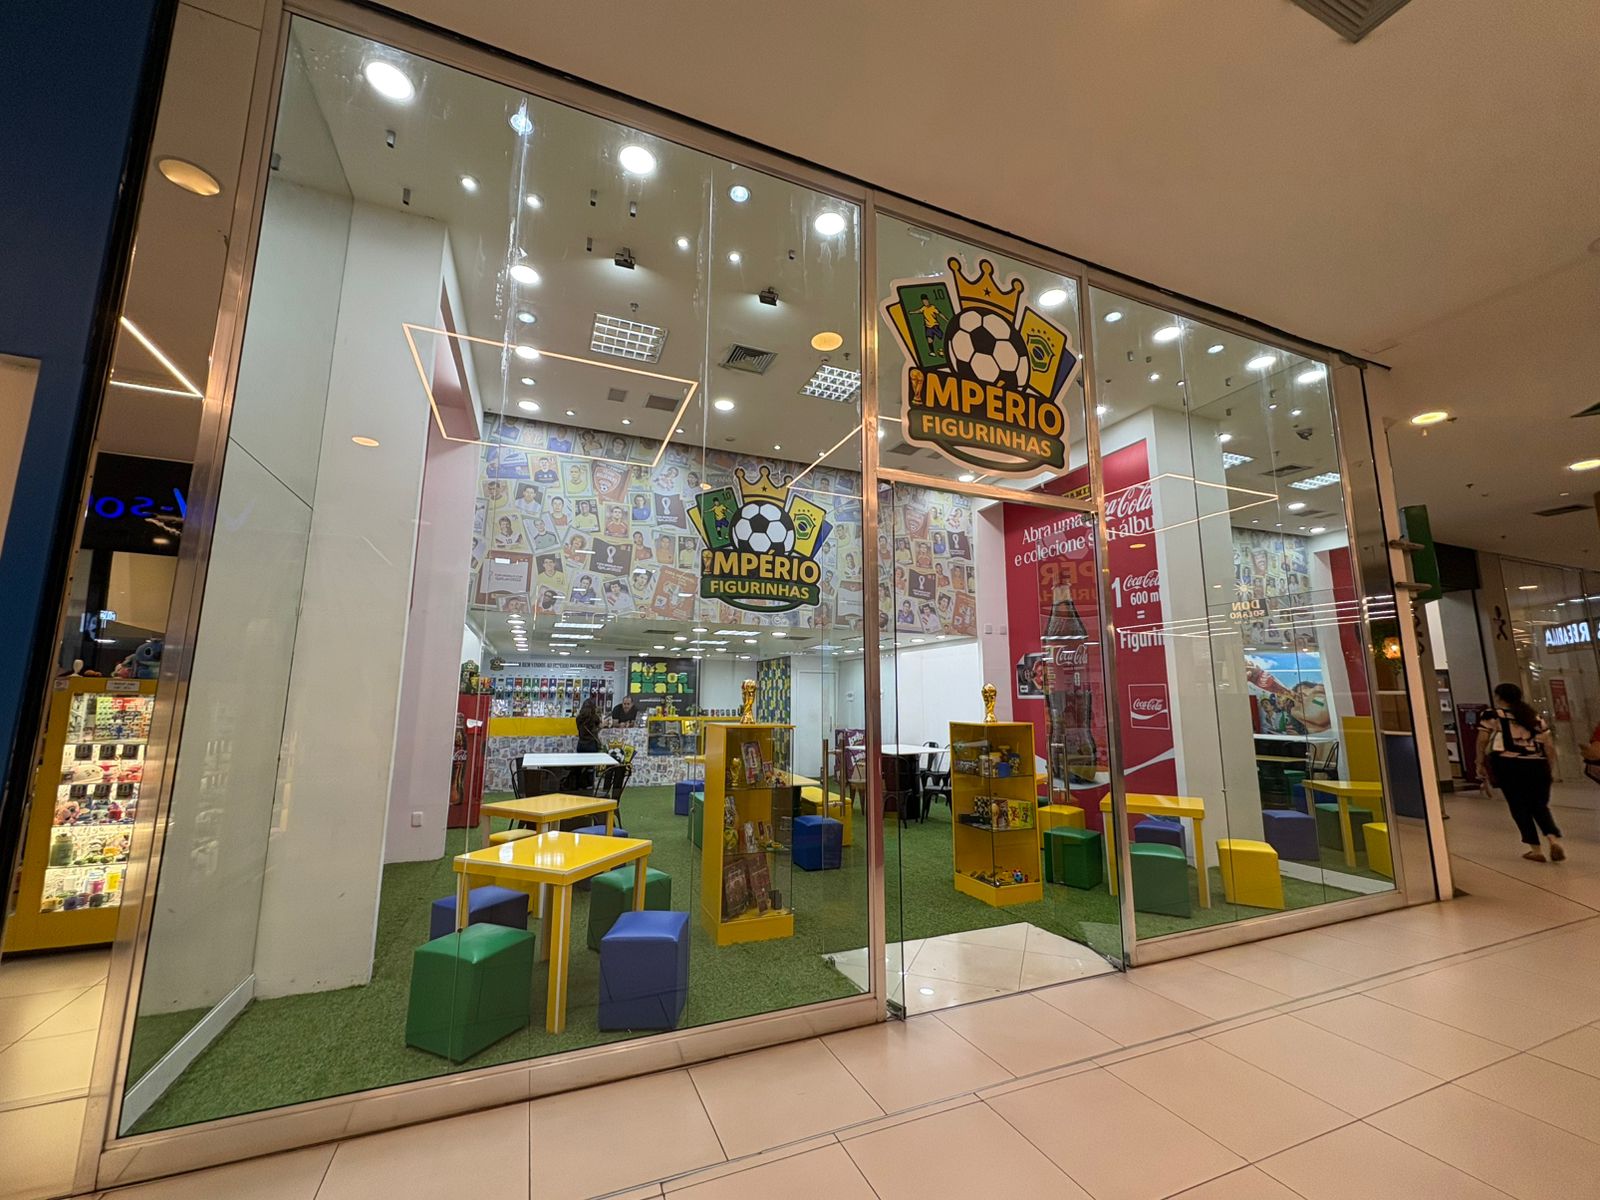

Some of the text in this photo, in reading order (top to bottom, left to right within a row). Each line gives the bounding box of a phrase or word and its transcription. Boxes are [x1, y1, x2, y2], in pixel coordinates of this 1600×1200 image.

[932, 288, 946, 301] 10
[922, 414, 1053, 458] FIGURINHAS
[721, 491, 732, 500] 10
[1022, 524, 1051, 545] Abra
[1053, 513, 1084, 533] uma
[1014, 515, 1154, 567] e colecione su álbu
[710, 580, 810, 599] FIGURINHAS
[1111, 576, 1123, 608] 1
[1130, 591, 1149, 606] 600
[1120, 625, 1165, 652] Figurin
[1055, 644, 1088, 666] Coca-Cola
[1132, 697, 1164, 711] Coca-Cola
